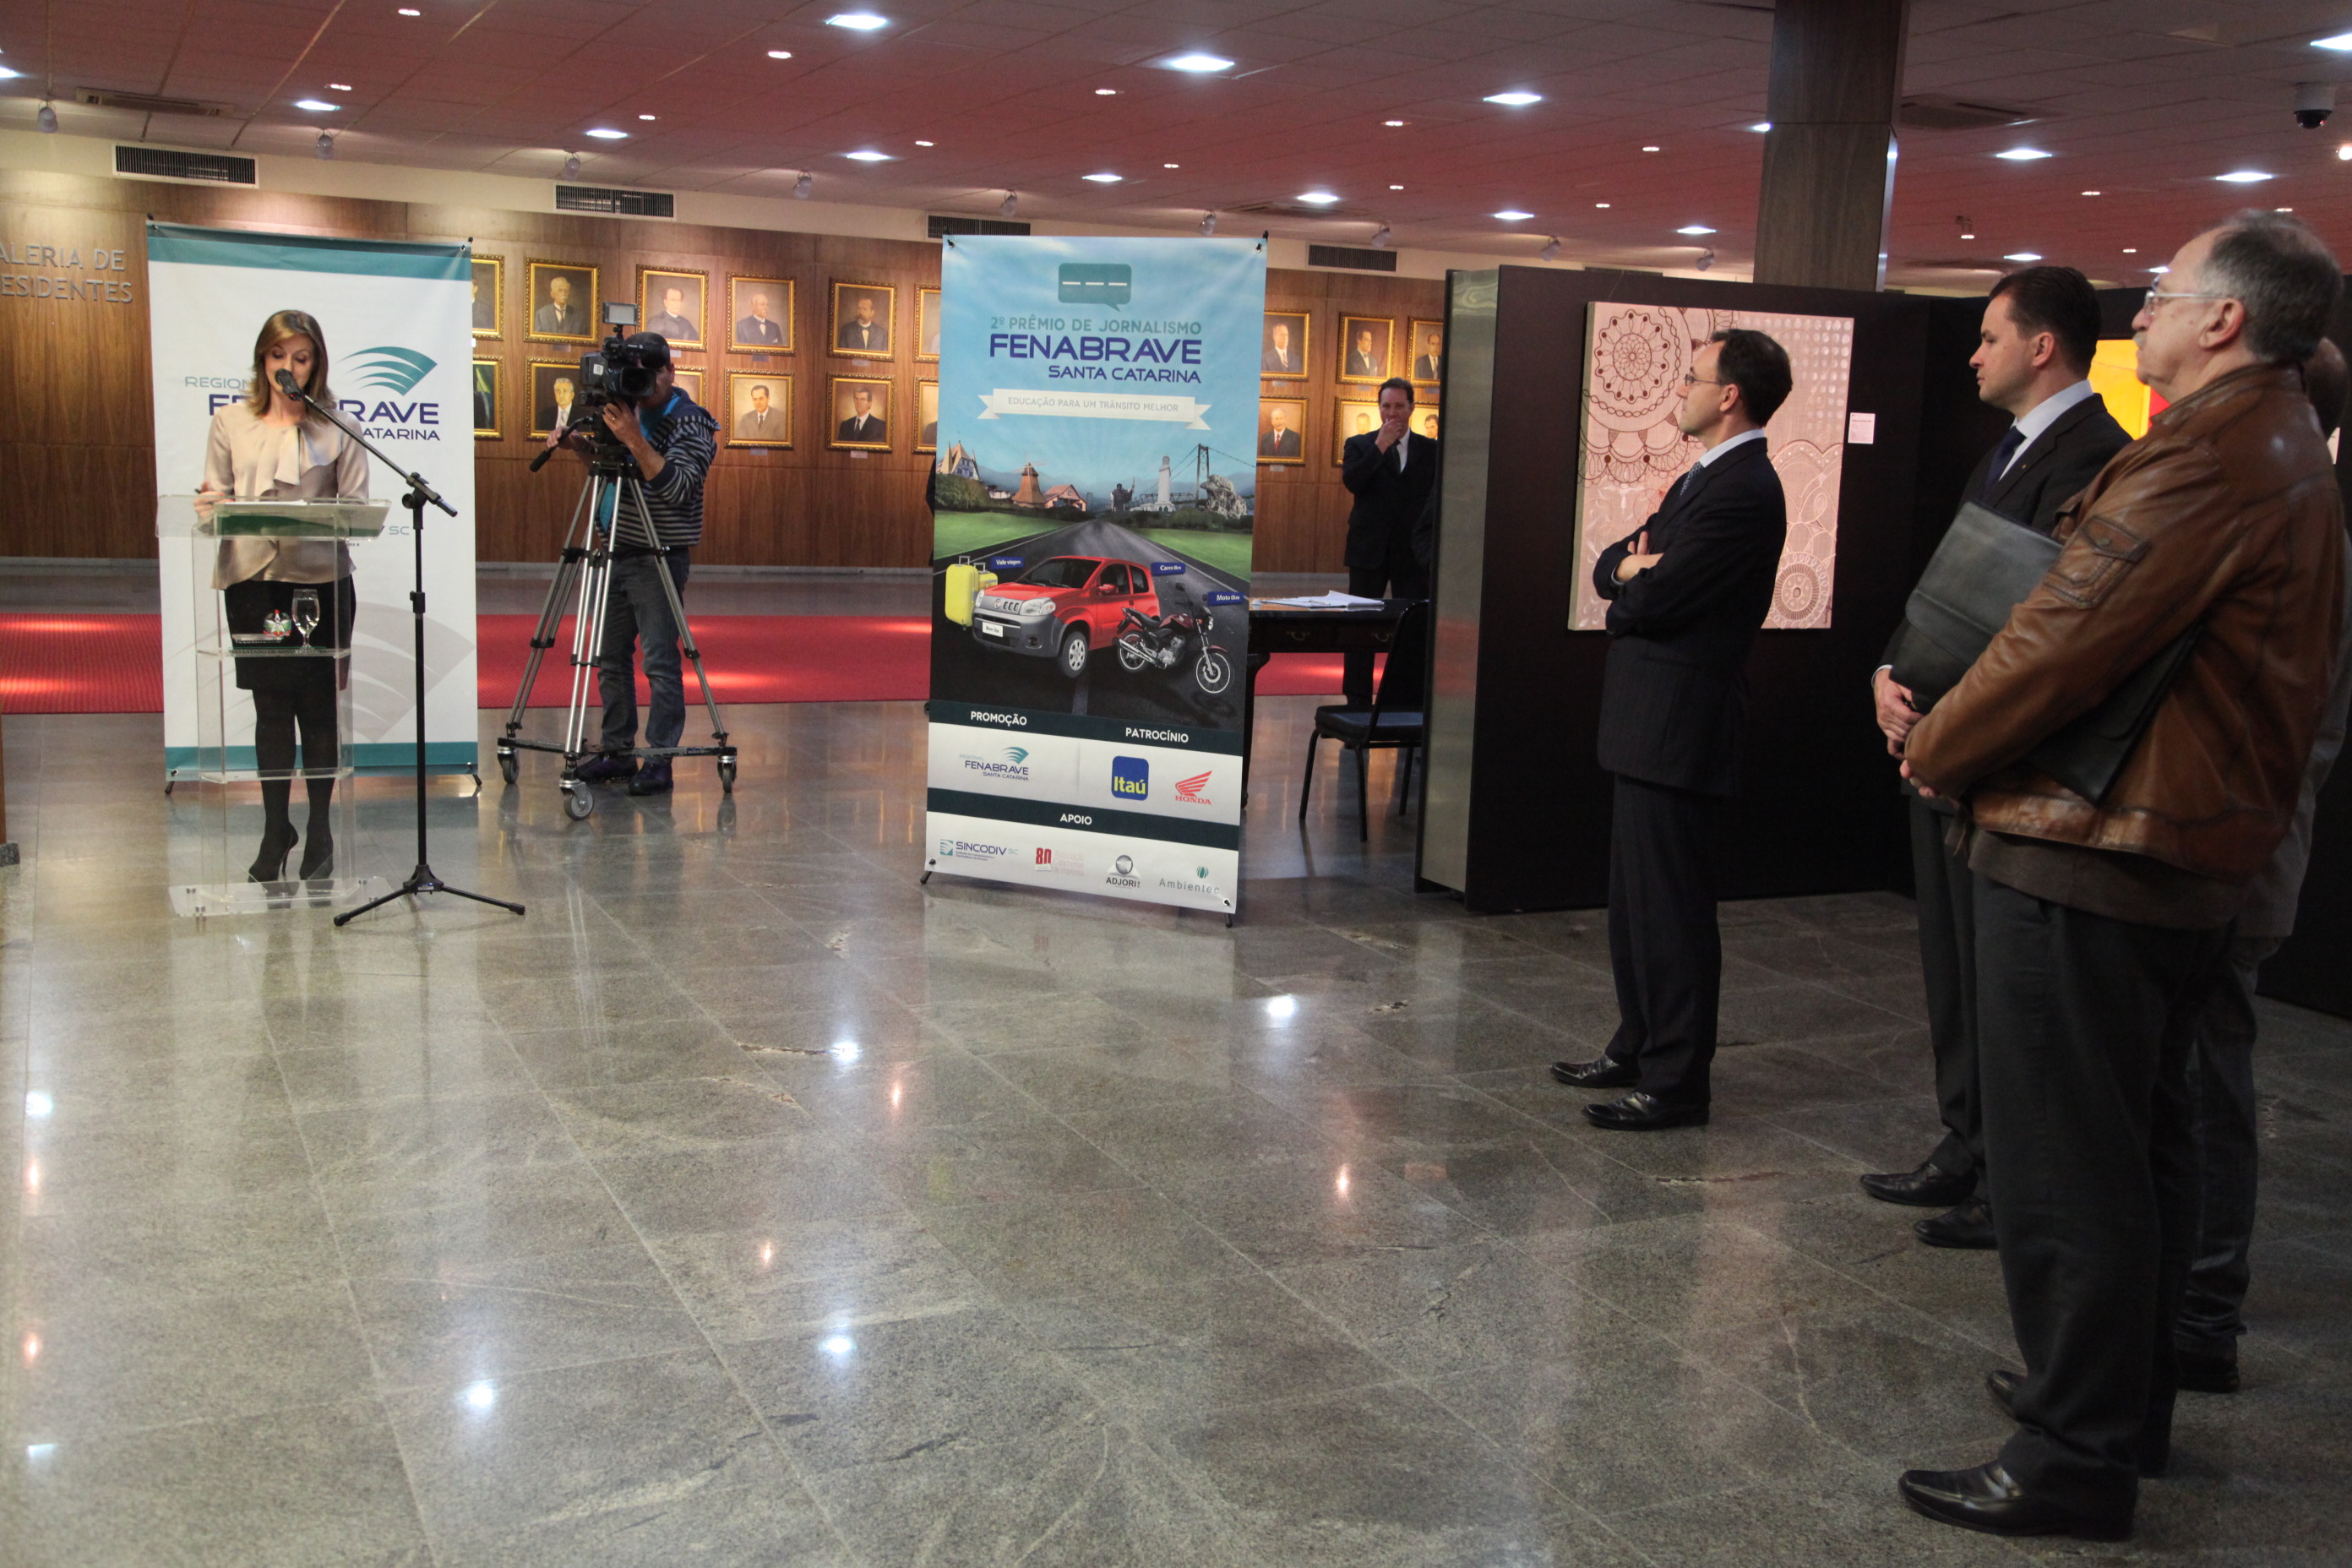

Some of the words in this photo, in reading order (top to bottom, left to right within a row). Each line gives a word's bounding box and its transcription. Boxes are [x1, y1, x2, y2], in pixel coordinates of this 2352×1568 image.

[94, 248, 126, 271] DE
[1009, 313, 1066, 331] PRÊMIO
[1071, 318, 1092, 332] DE
[1098, 319, 1202, 335] JORNALISMO
[989, 333, 1202, 365] FENABRAVE
[1048, 364, 1108, 380] SANTA
[1111, 367, 1202, 384] CATARINA
[1008, 395, 1056, 408] EDUCAÇÃO
[1058, 400, 1081, 408] PARA
[1083, 400, 1097, 409] UM
[1099, 399, 1141, 411] TRÂNSITO
[1143, 403, 1179, 412] MELHOR
[388, 525, 411, 536] SC
[971, 710, 1027, 727] PROMOÇÃO
[1125, 727, 1190, 743] PATROCÍNIO
[965, 760, 1029, 776] FENABRAVE
[1002, 773, 1029, 781] CATARINA
[1113, 776, 1146, 795] Itaú
[1174, 795, 1211, 805] HONDA
[1059, 813, 1092, 825] APOIO
[956, 841, 1007, 856] SINCODIV
[1105, 876, 1137, 888] ADJORI
[1158, 878, 1221, 895] Ambientec
